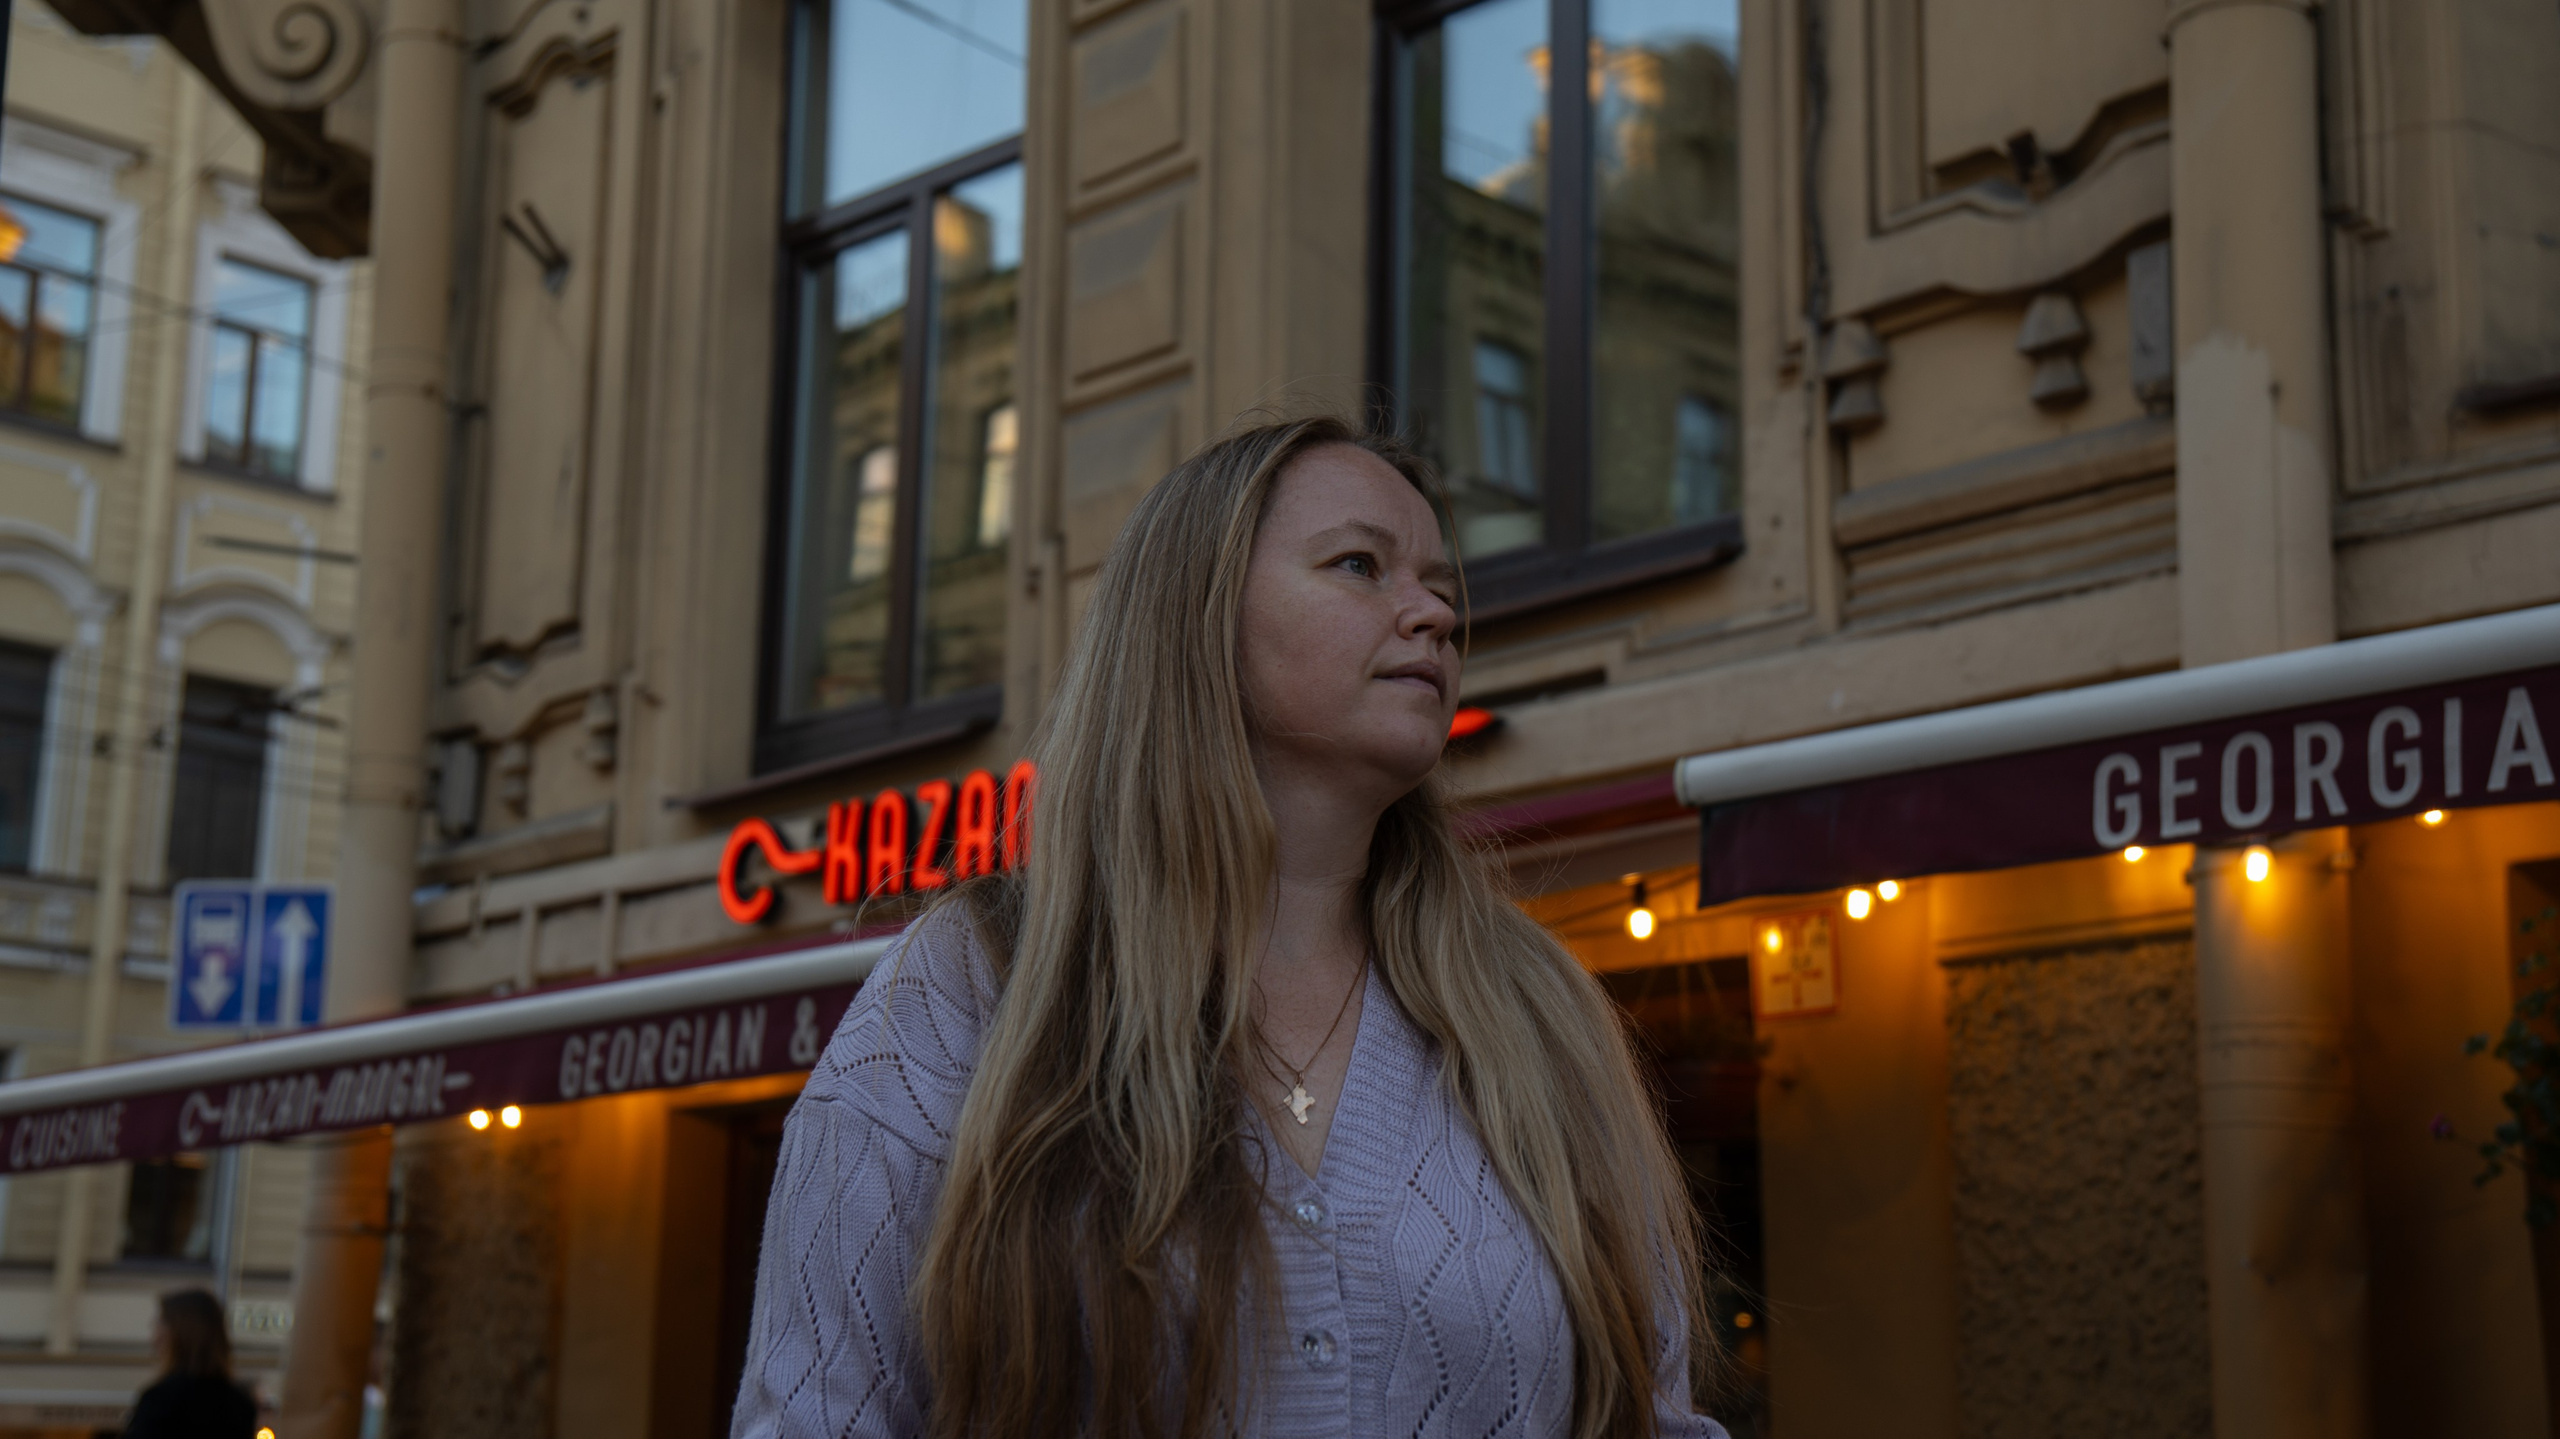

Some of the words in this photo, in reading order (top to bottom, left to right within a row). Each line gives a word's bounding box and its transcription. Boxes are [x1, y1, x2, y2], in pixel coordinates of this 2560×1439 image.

[559, 1003, 767, 1099] GEORGIAN
[789, 996, 820, 1066] &
[9, 1101, 124, 1170] CUISINE
